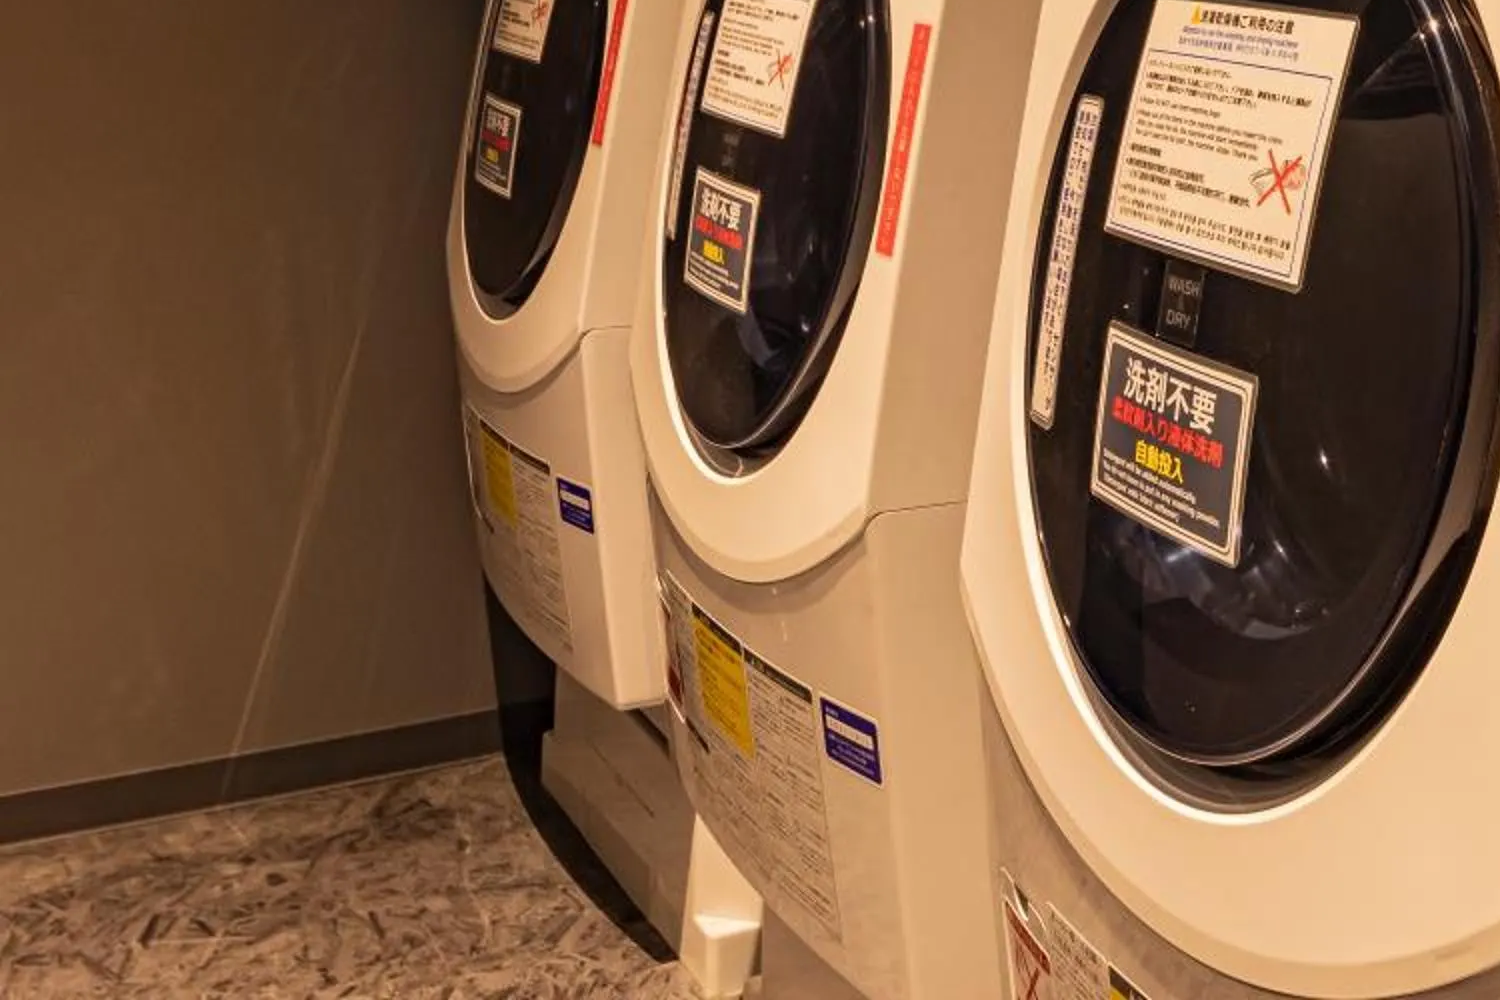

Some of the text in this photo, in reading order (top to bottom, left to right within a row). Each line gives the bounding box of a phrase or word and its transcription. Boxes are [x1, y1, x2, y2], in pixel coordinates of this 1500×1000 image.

[1168, 276, 1199, 297] WASH
[1165, 308, 1191, 328] DRY
[1122, 357, 1217, 435] 洗剤不要
[1135, 438, 1183, 484] 自動投入
